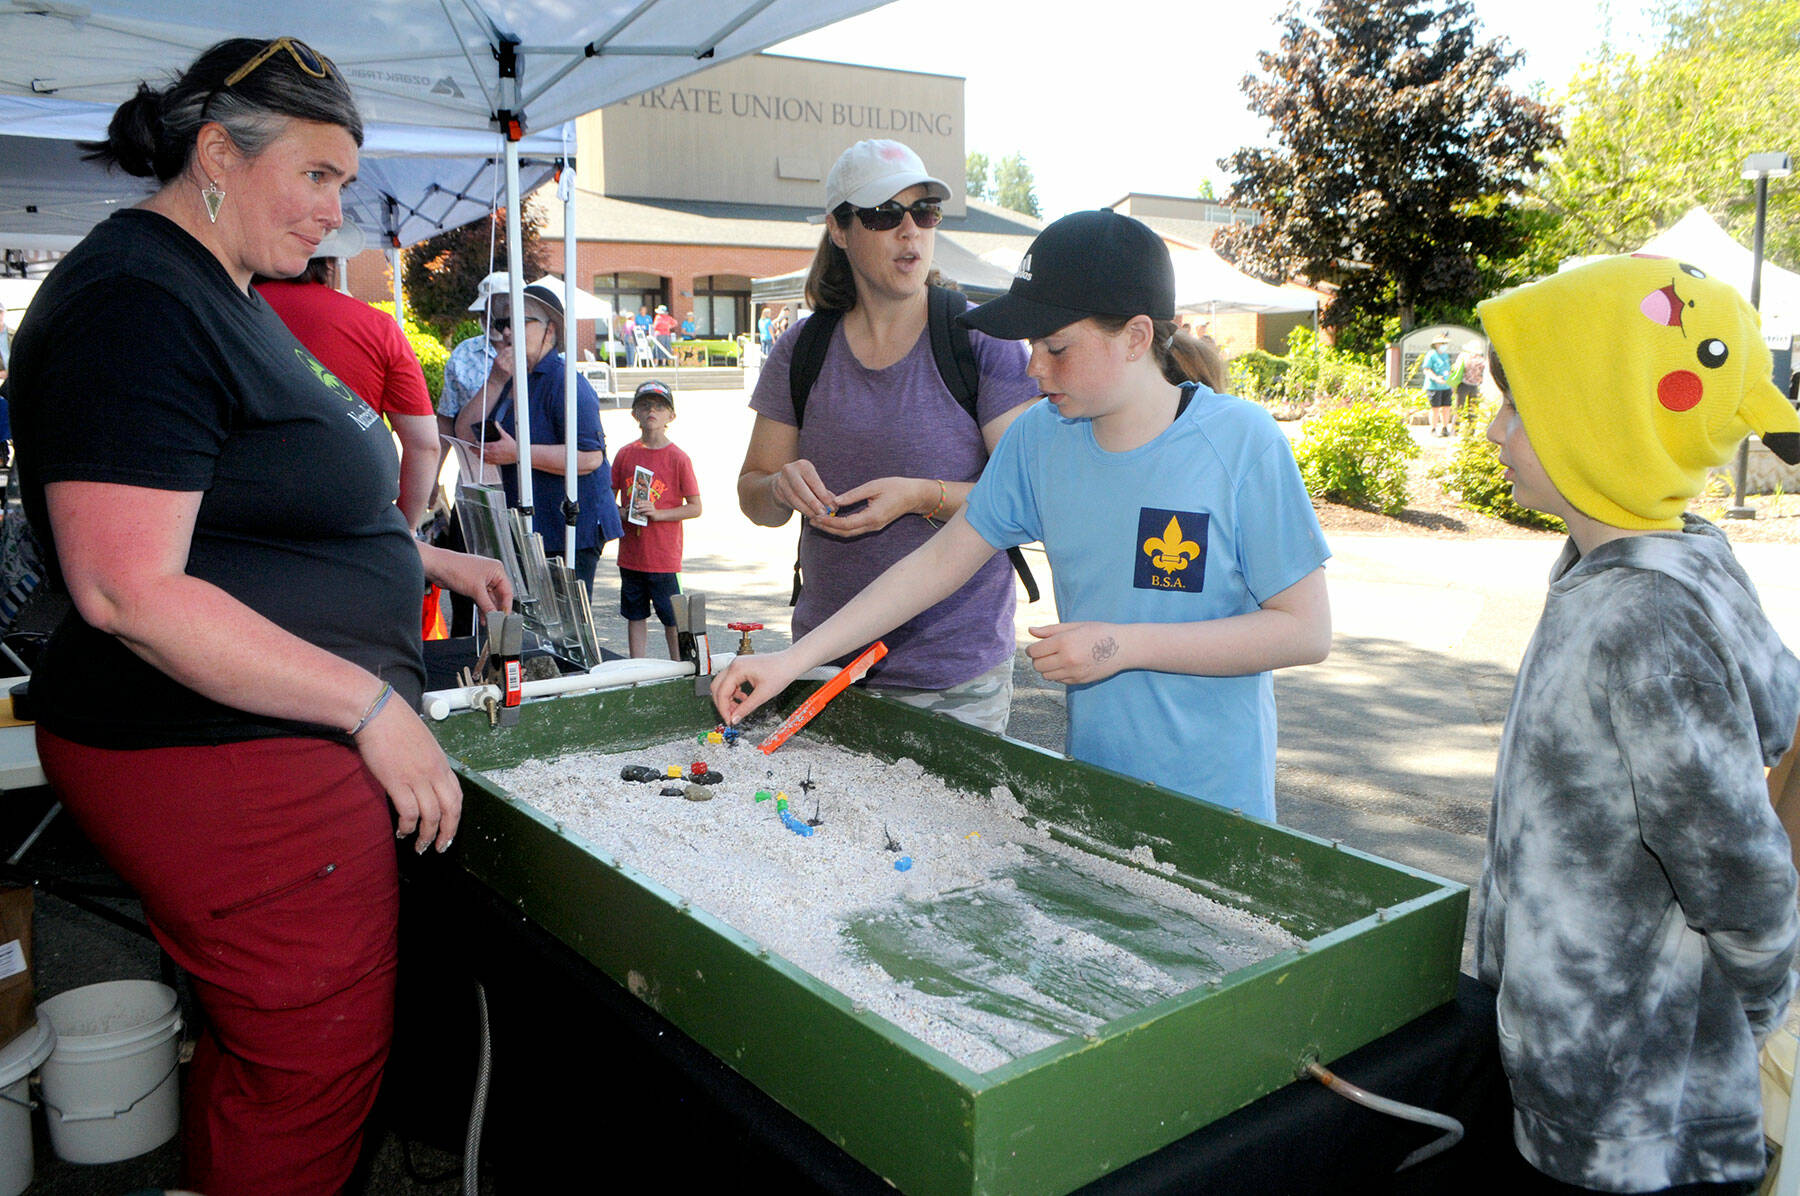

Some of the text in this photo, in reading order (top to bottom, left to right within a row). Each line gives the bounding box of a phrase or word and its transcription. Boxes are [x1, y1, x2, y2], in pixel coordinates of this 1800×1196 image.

[622, 87, 953, 137] IRATE UNION BUILDING
[1151, 575, 1186, 588] B.S.A.
